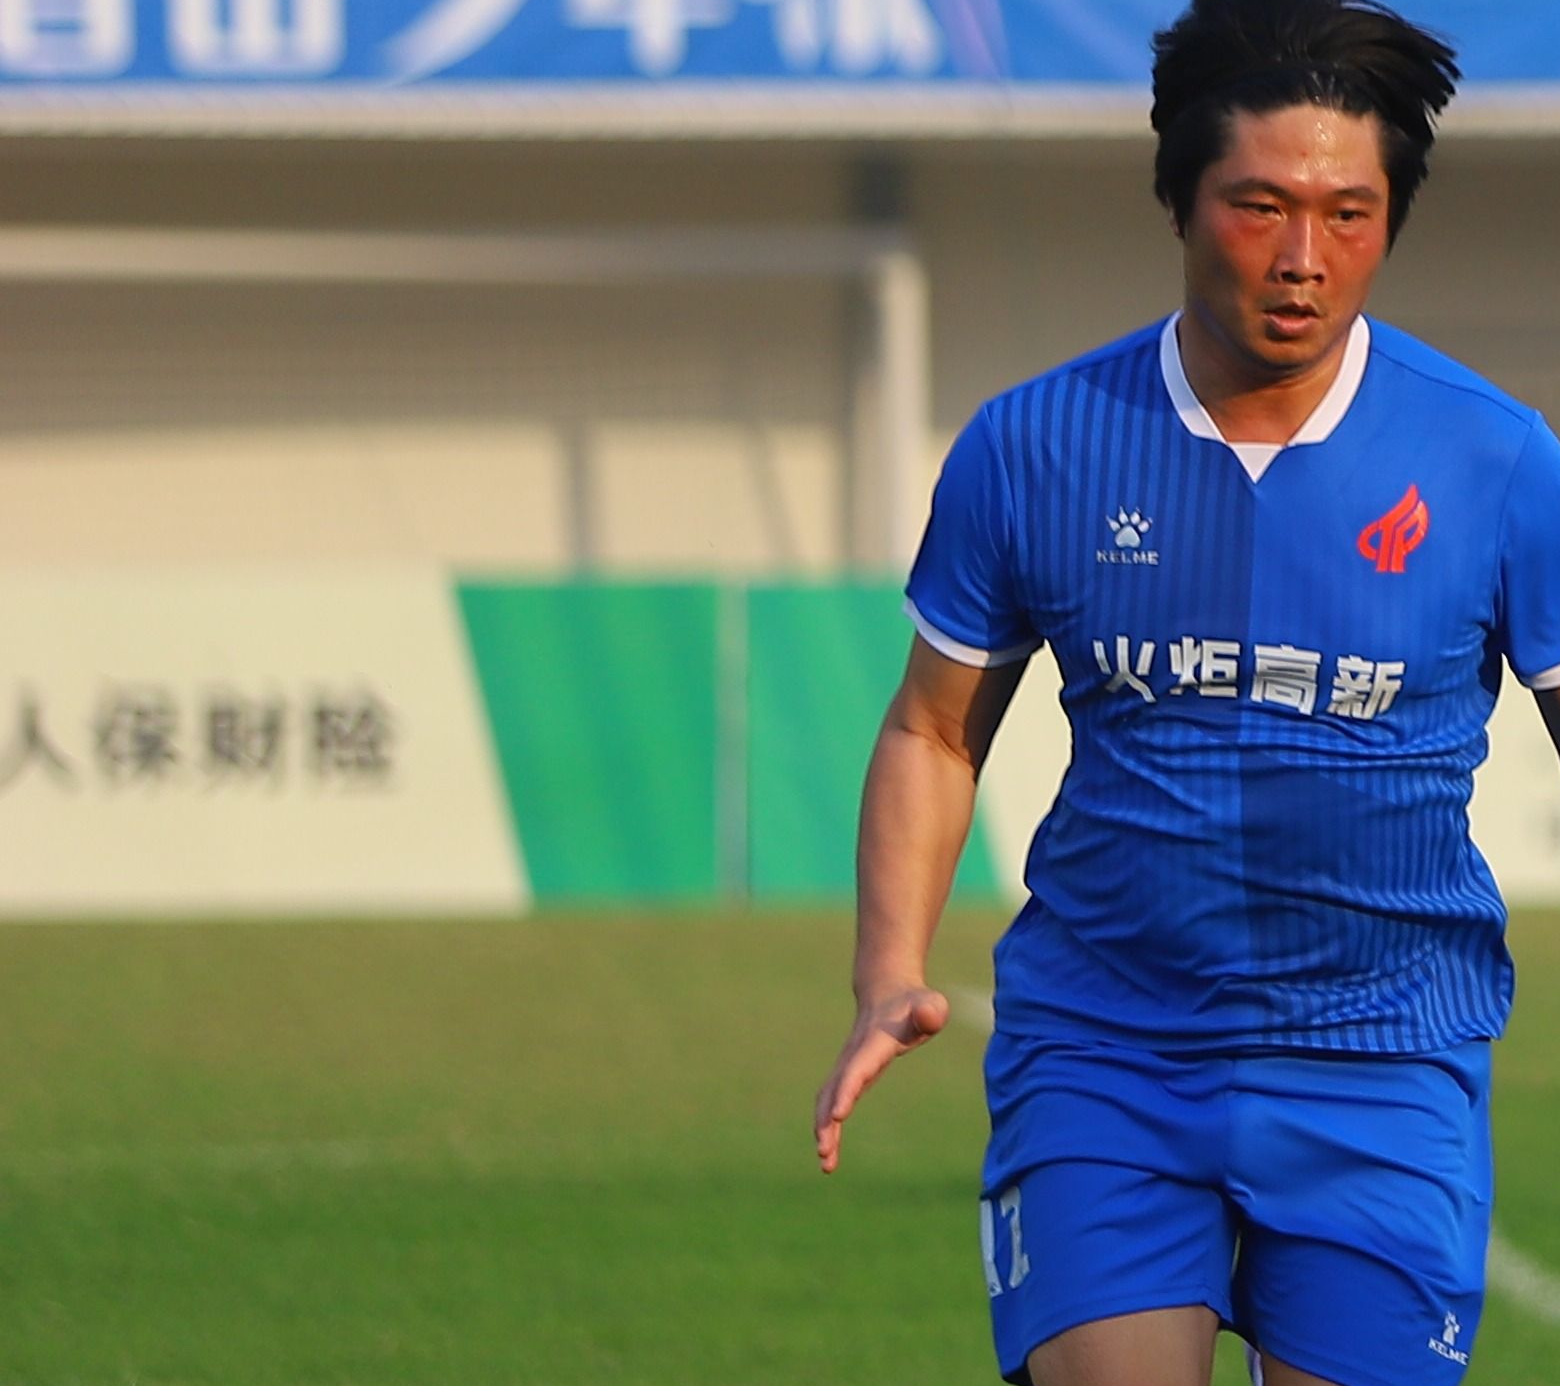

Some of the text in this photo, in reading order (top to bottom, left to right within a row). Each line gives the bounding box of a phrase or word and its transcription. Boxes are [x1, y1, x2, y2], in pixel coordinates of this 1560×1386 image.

[1096, 549, 1159, 565] KELME
[1092, 636, 1405, 720] 火炬高新
[0, 683, 398, 791] 人保财险
